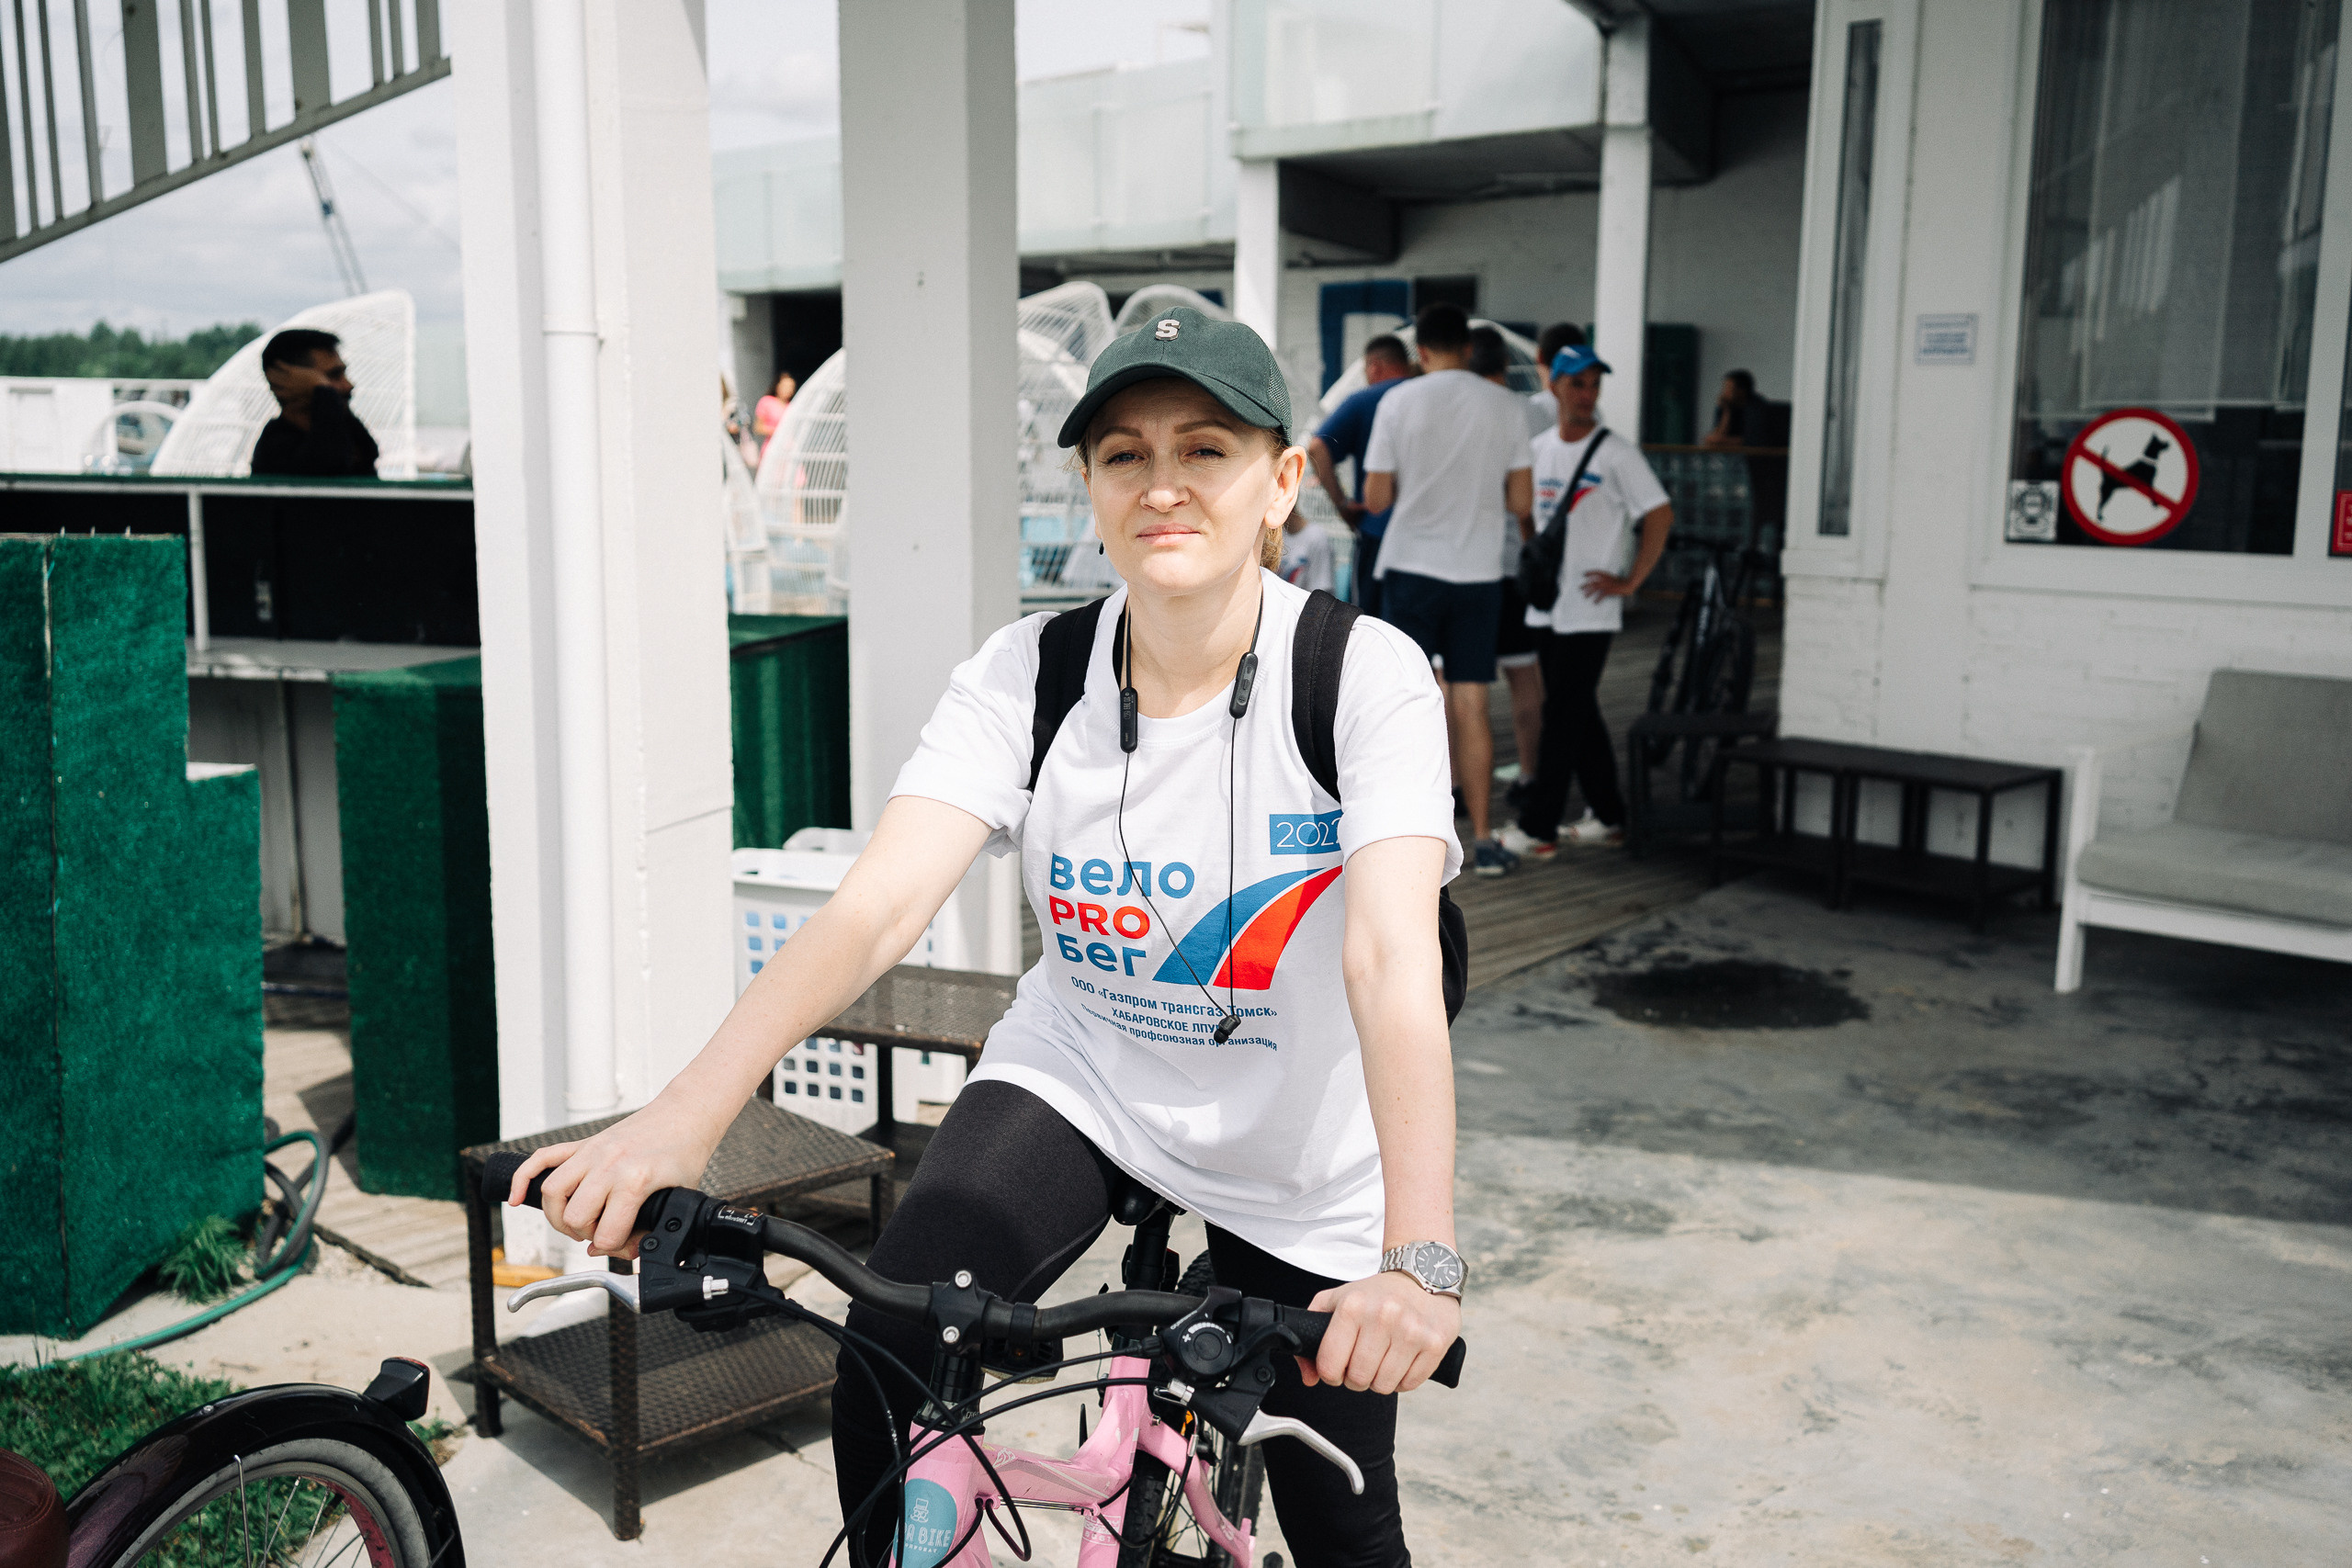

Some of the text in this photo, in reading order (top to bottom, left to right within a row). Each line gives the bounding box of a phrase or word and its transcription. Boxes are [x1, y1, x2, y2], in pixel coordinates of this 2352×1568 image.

[1155, 319, 1181, 341] S
[1048, 895, 1150, 940] PRO
[1070, 976, 1095, 994] ООО
[1098, 987, 1158, 1010] «Газпром
[1160, 1001, 1224, 1017] трансгаз
[1111, 1007, 1189, 1032] ХАБАРОВСКОЕ
[1129, 1027, 1205, 1045] профсоюзная
[1208, 1037, 1277, 1051] оанизация
[918, 1527, 952, 1547] BIKE
